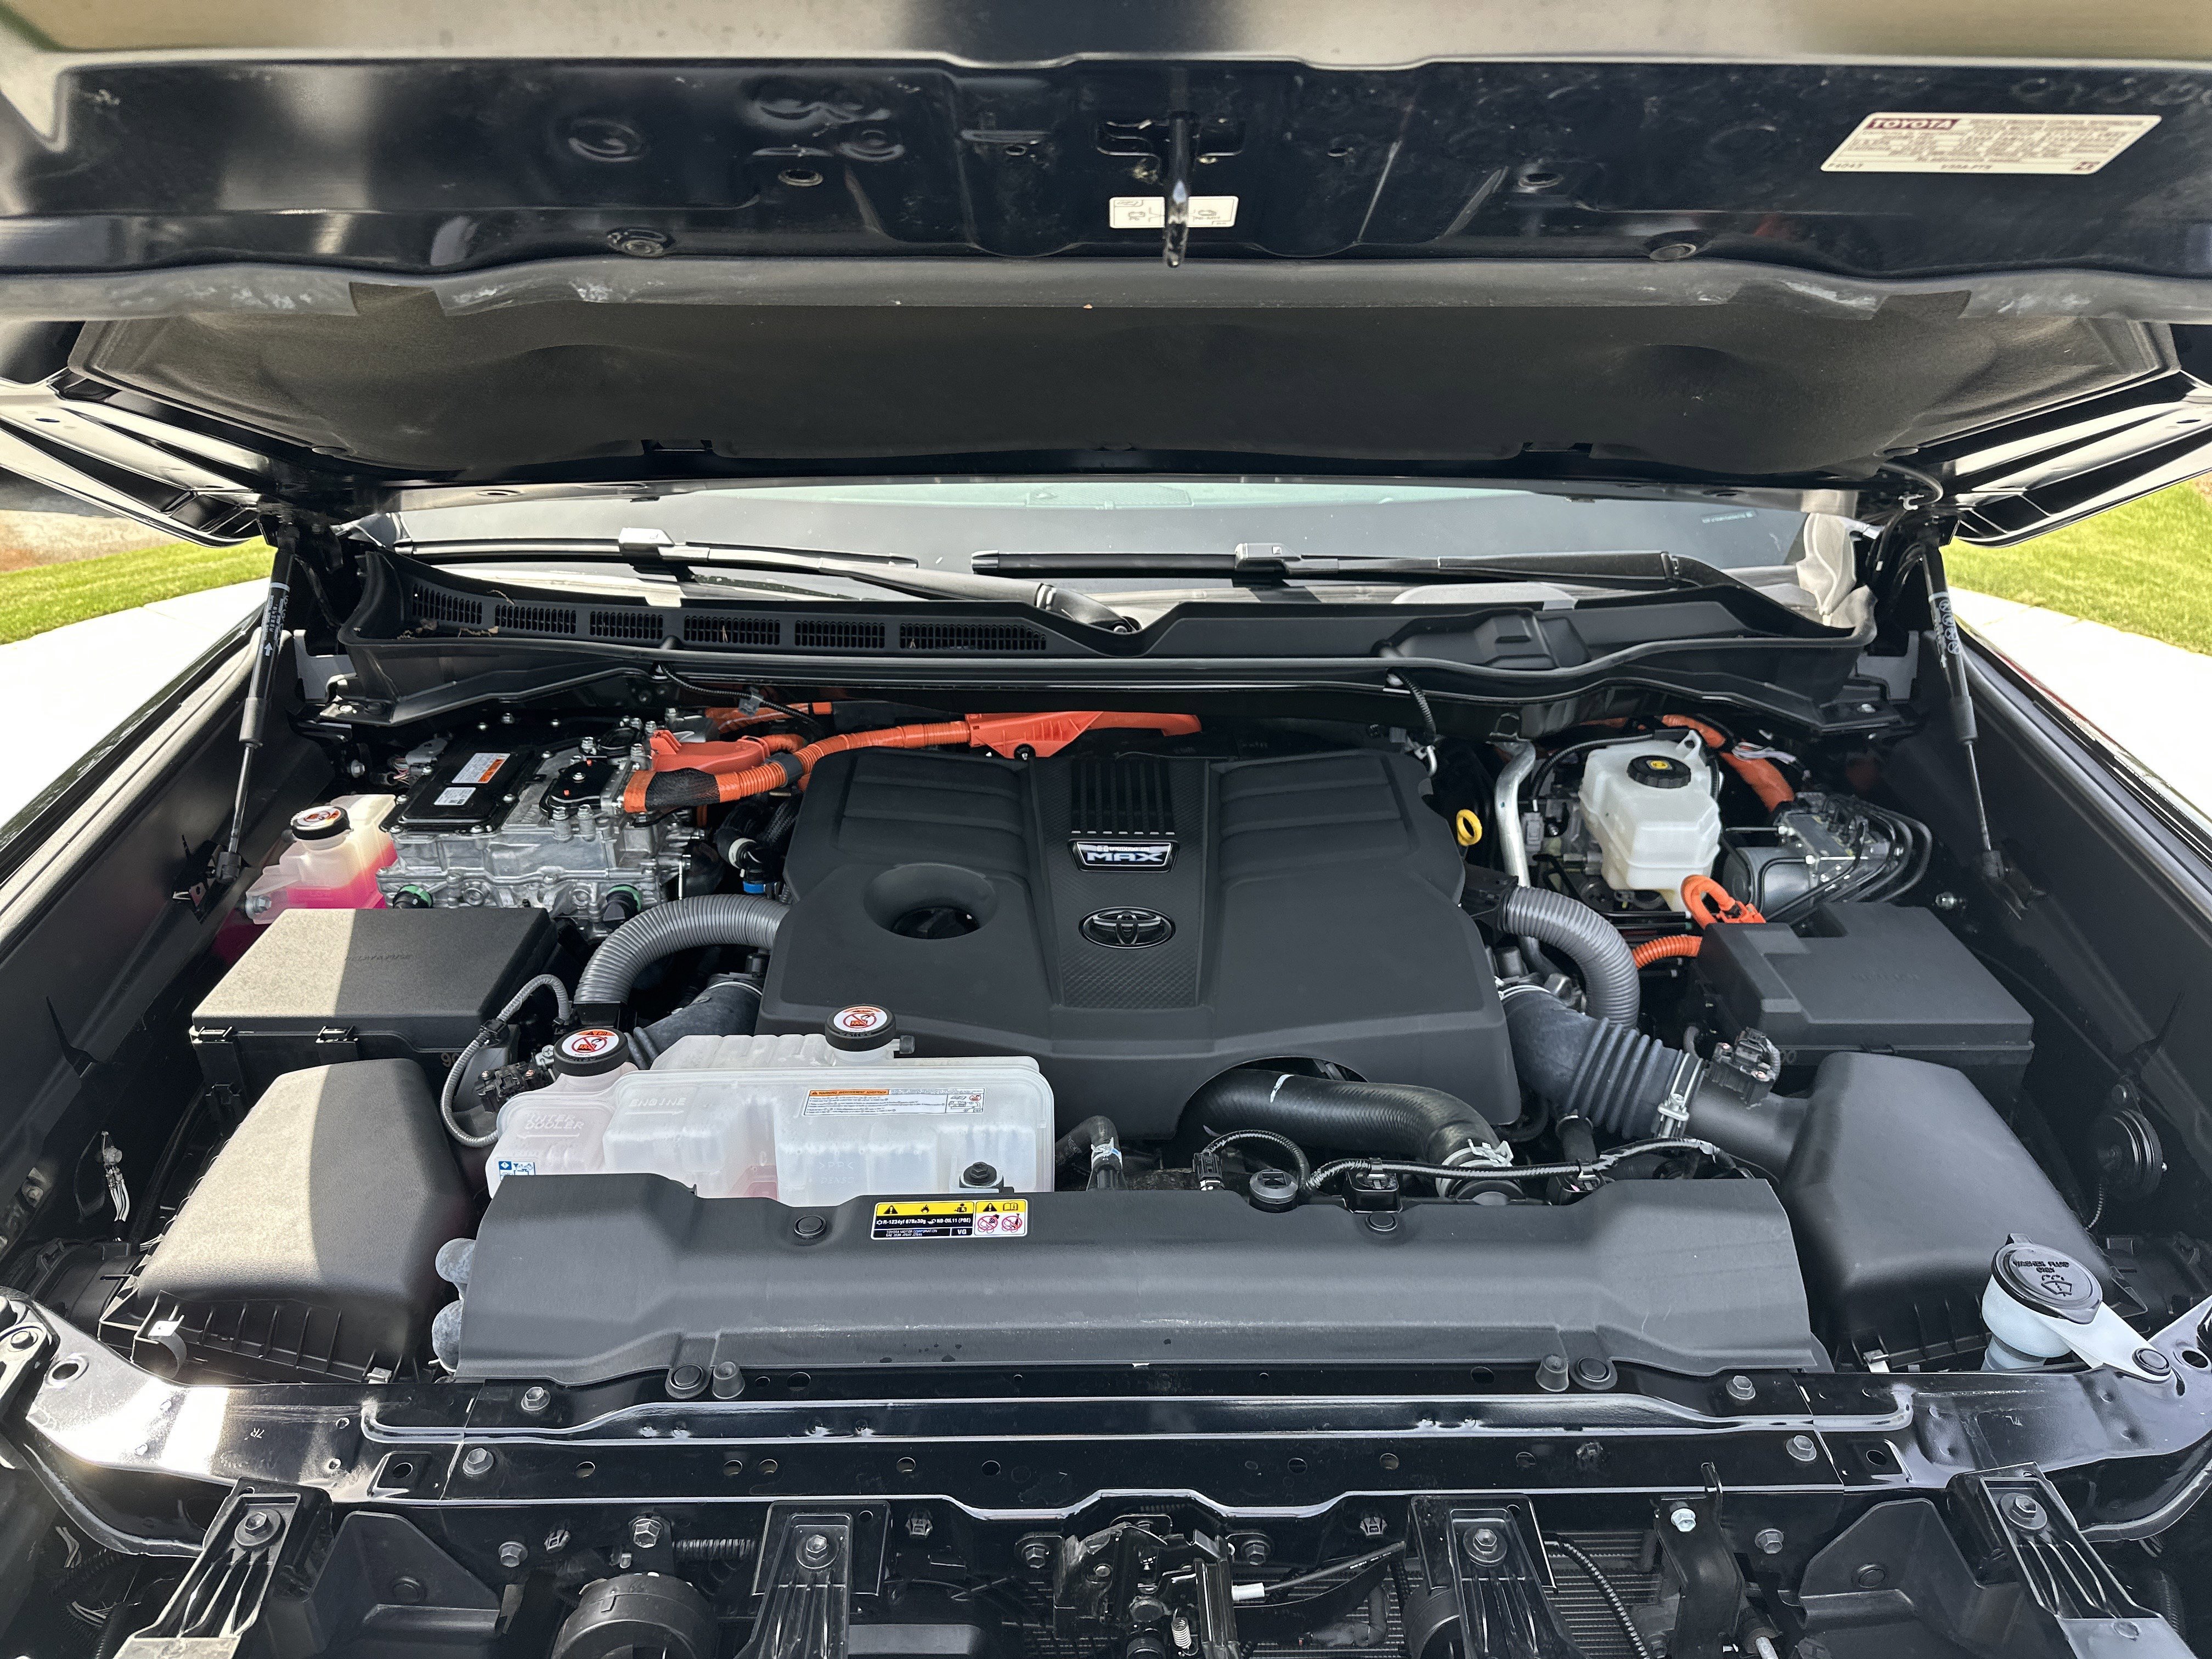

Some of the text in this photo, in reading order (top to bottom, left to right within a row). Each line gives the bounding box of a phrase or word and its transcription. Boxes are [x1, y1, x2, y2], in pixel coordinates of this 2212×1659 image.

[1870, 118, 1955, 129] TOYOTA
[1087, 852, 1163, 862] MAX
[629, 1097, 687, 1107] ENGINE
[527, 1114, 576, 1122] INTER
